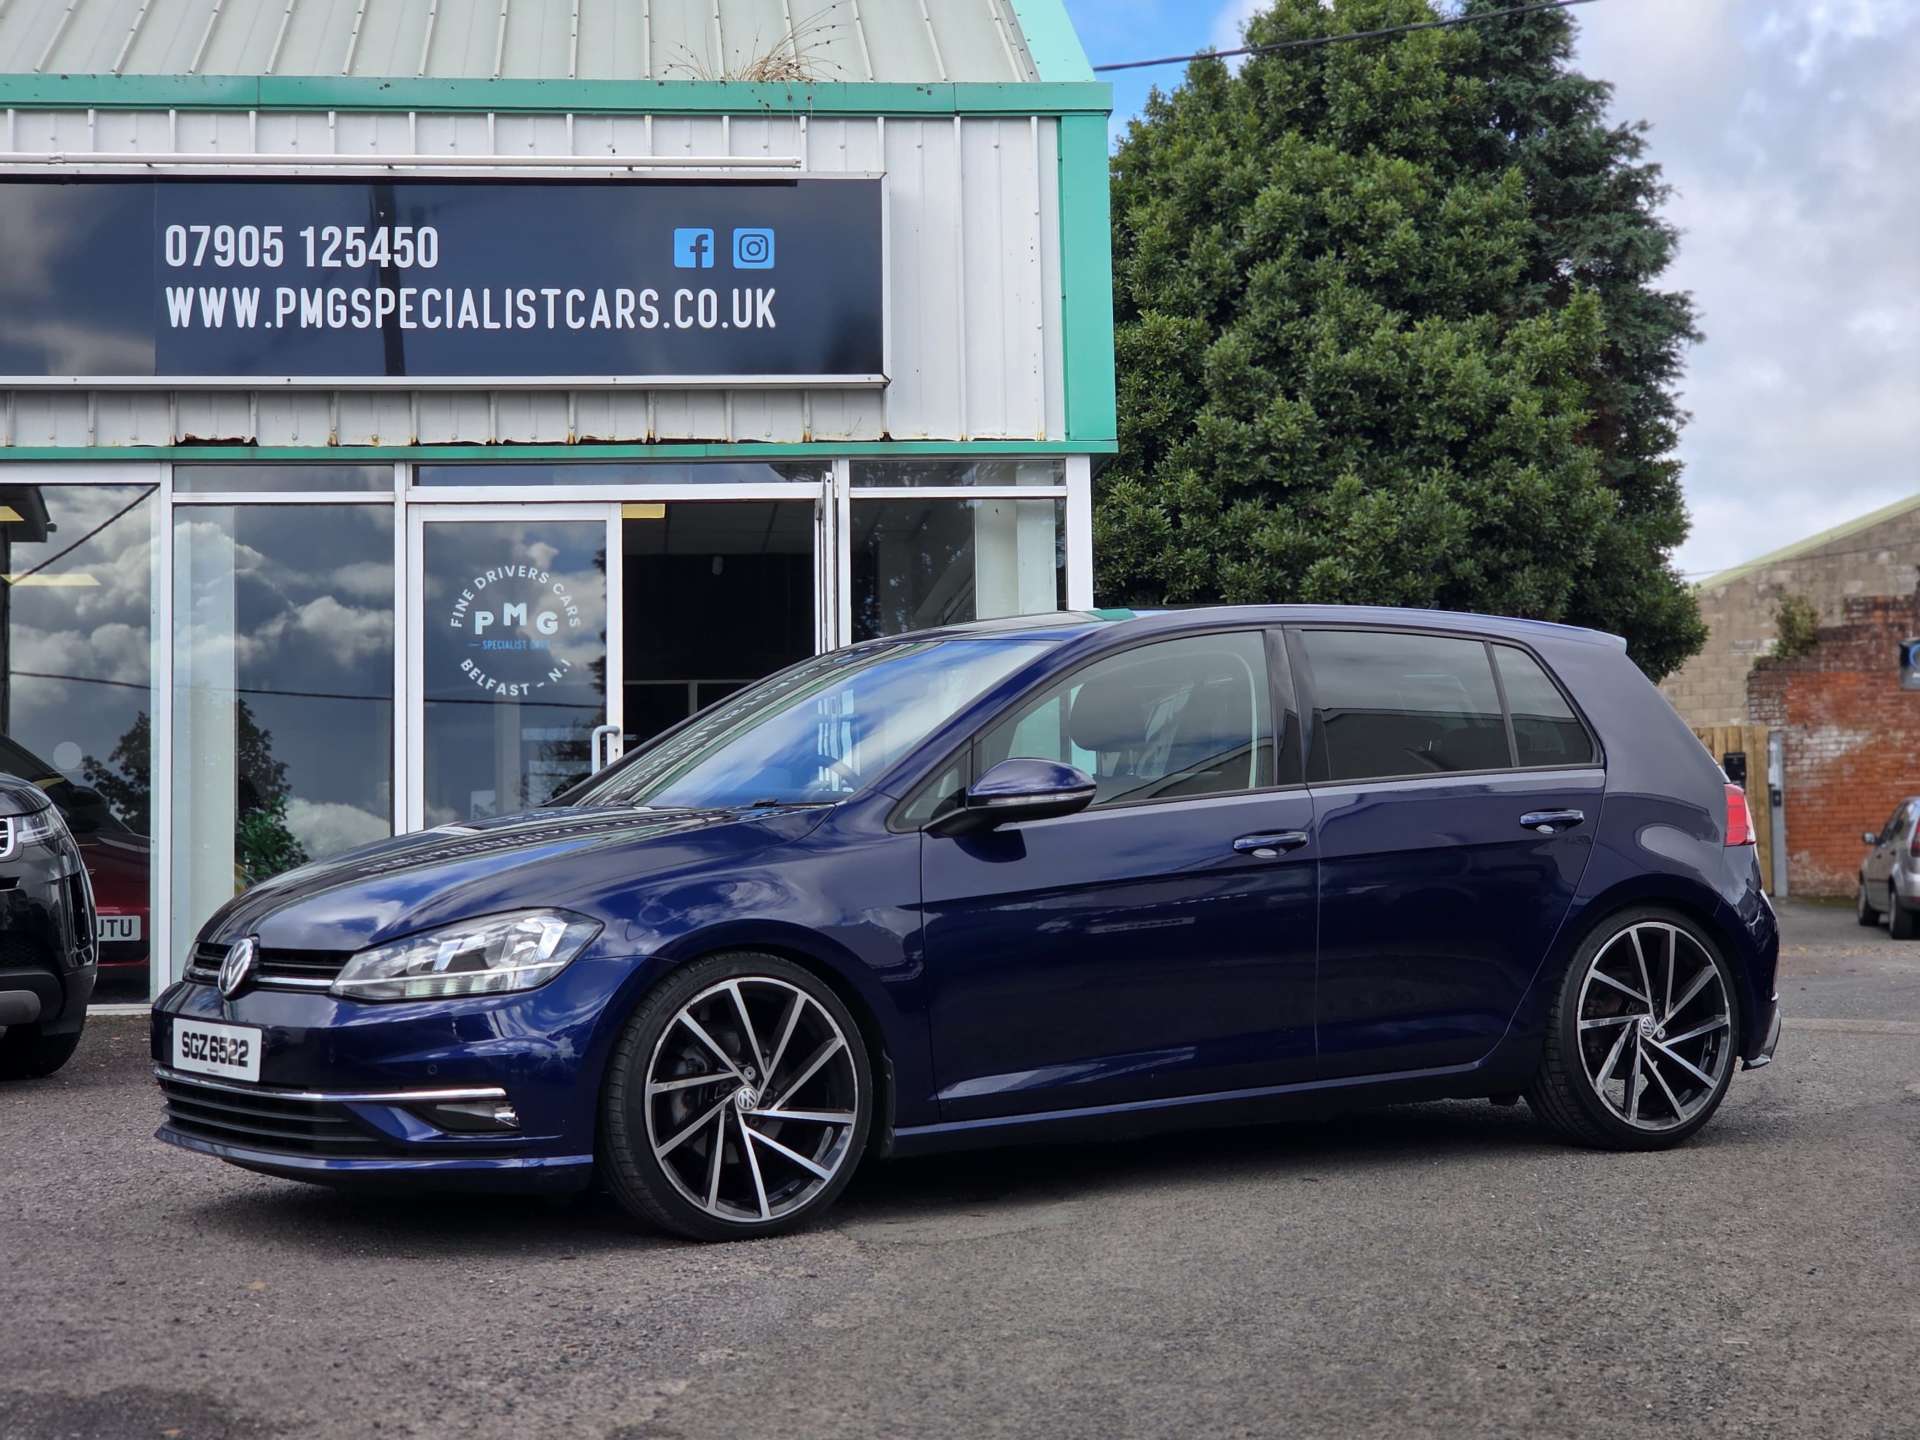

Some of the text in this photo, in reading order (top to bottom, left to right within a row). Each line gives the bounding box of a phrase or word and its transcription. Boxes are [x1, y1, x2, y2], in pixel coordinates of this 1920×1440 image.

[165, 224, 439, 269] 07905 125450
[165, 286, 777, 330] WWW.PMGSPECIALISTCARS.CO.UK
[450, 564, 581, 628] FINE DRIVERS CARS
[474, 602, 559, 635] PMG
[460, 658, 530, 697] BELFAST
